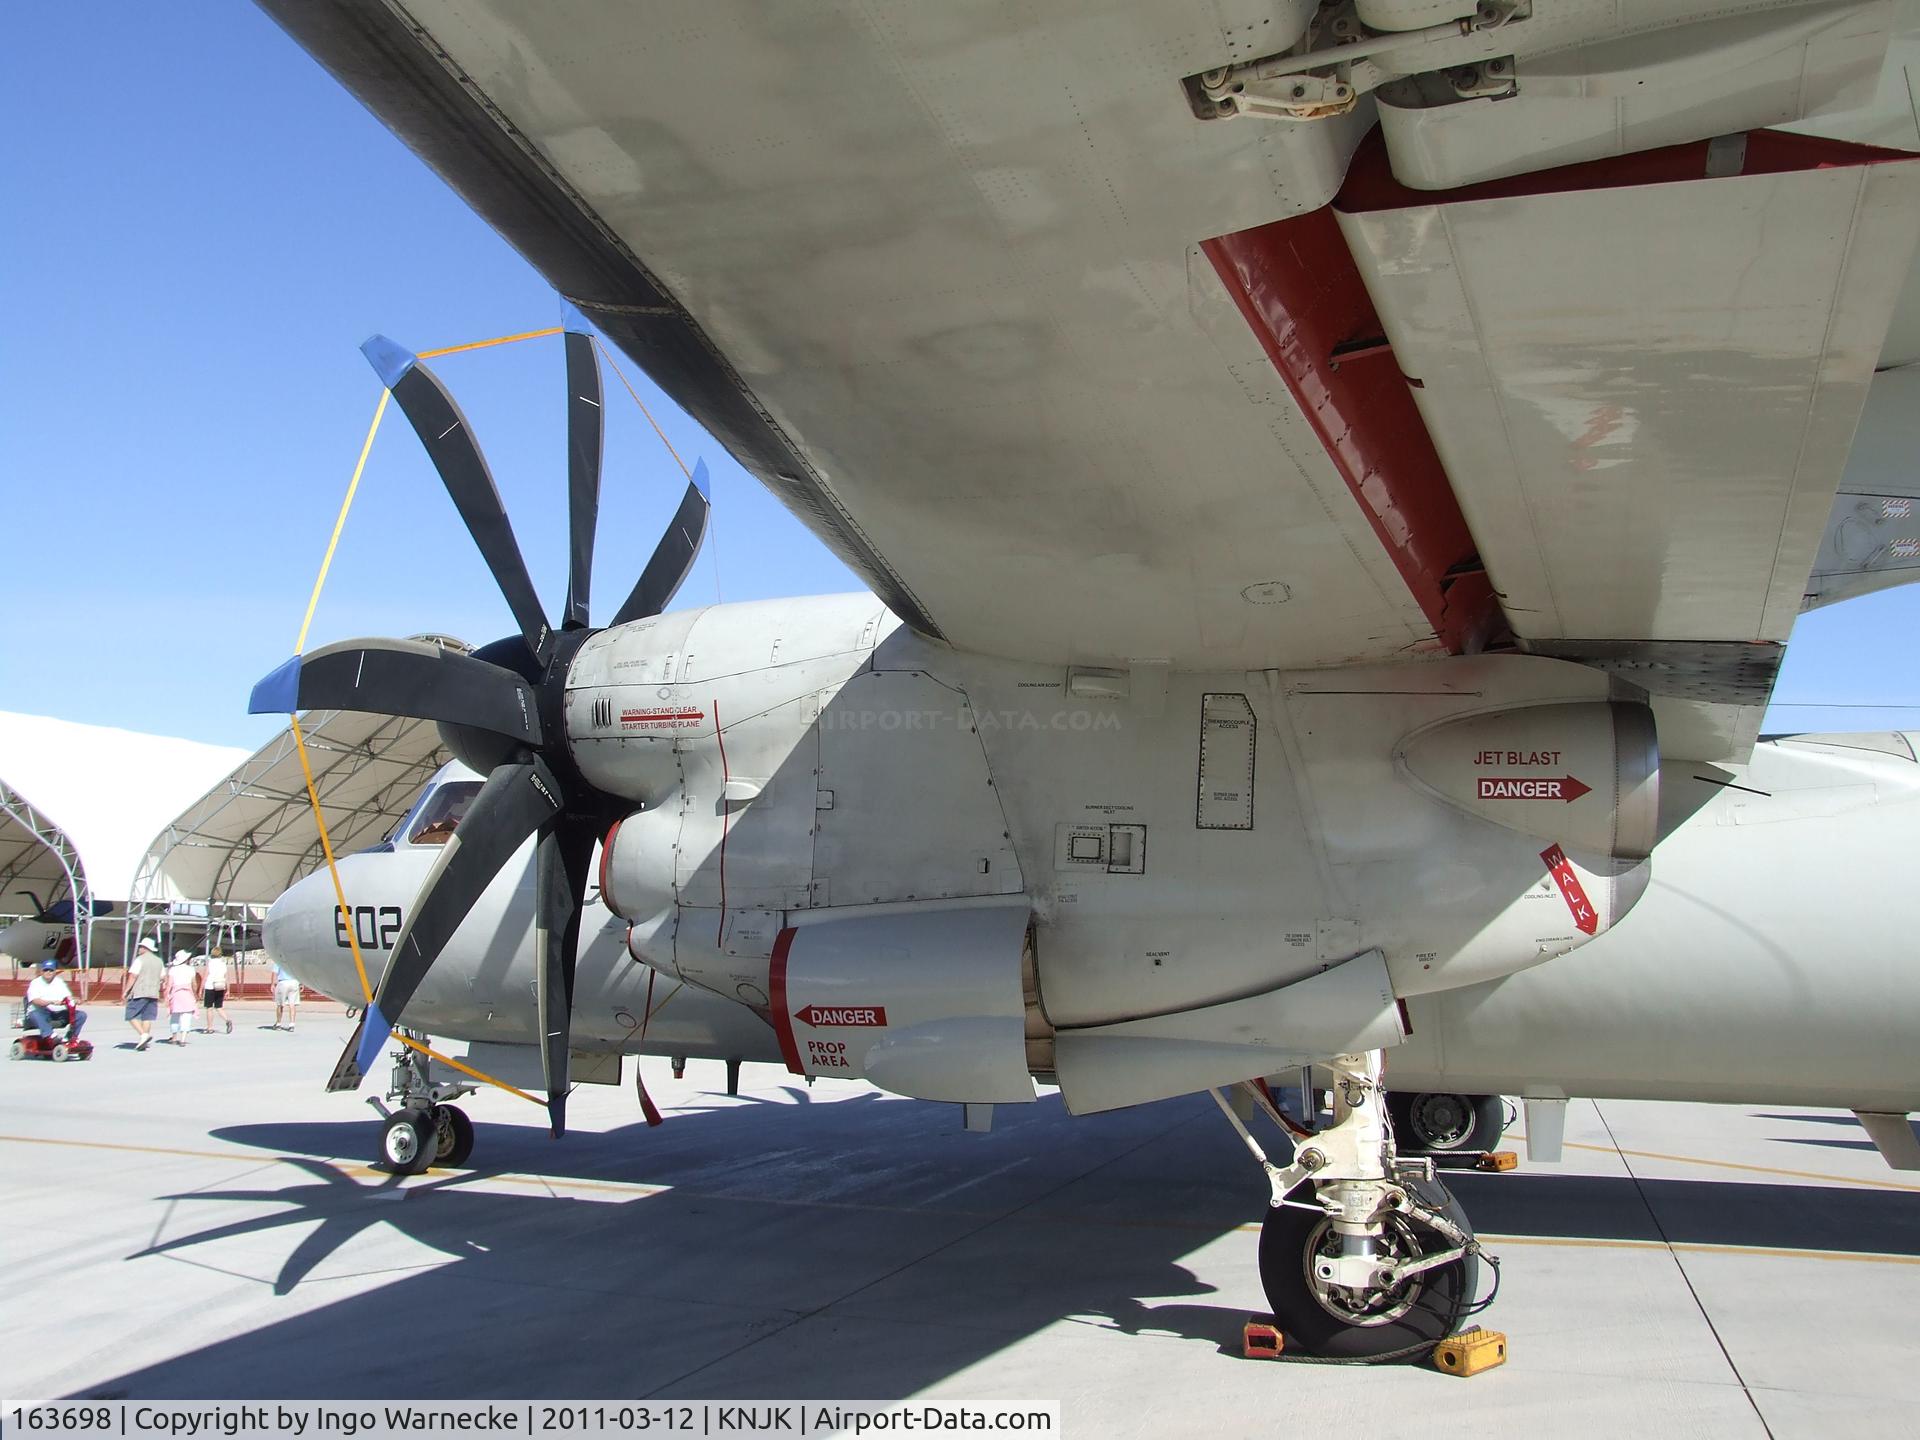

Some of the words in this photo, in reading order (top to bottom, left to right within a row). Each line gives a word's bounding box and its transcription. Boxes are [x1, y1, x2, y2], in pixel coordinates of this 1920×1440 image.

[676, 706, 697, 714] CLEAR
[621, 722, 650, 731] STARTER
[650, 721, 677, 729] TURBINE
[678, 720, 701, 728] PLANE
[1474, 751, 1503, 765] JET
[1507, 751, 1561, 765] BLAST
[1481, 781, 1561, 797] DANGER
[1548, 851, 1590, 920] WALK
[811, 1010, 877, 1024] DANGER
[808, 1041, 846, 1054] PROP
[811, 1055, 850, 1068] AREA
